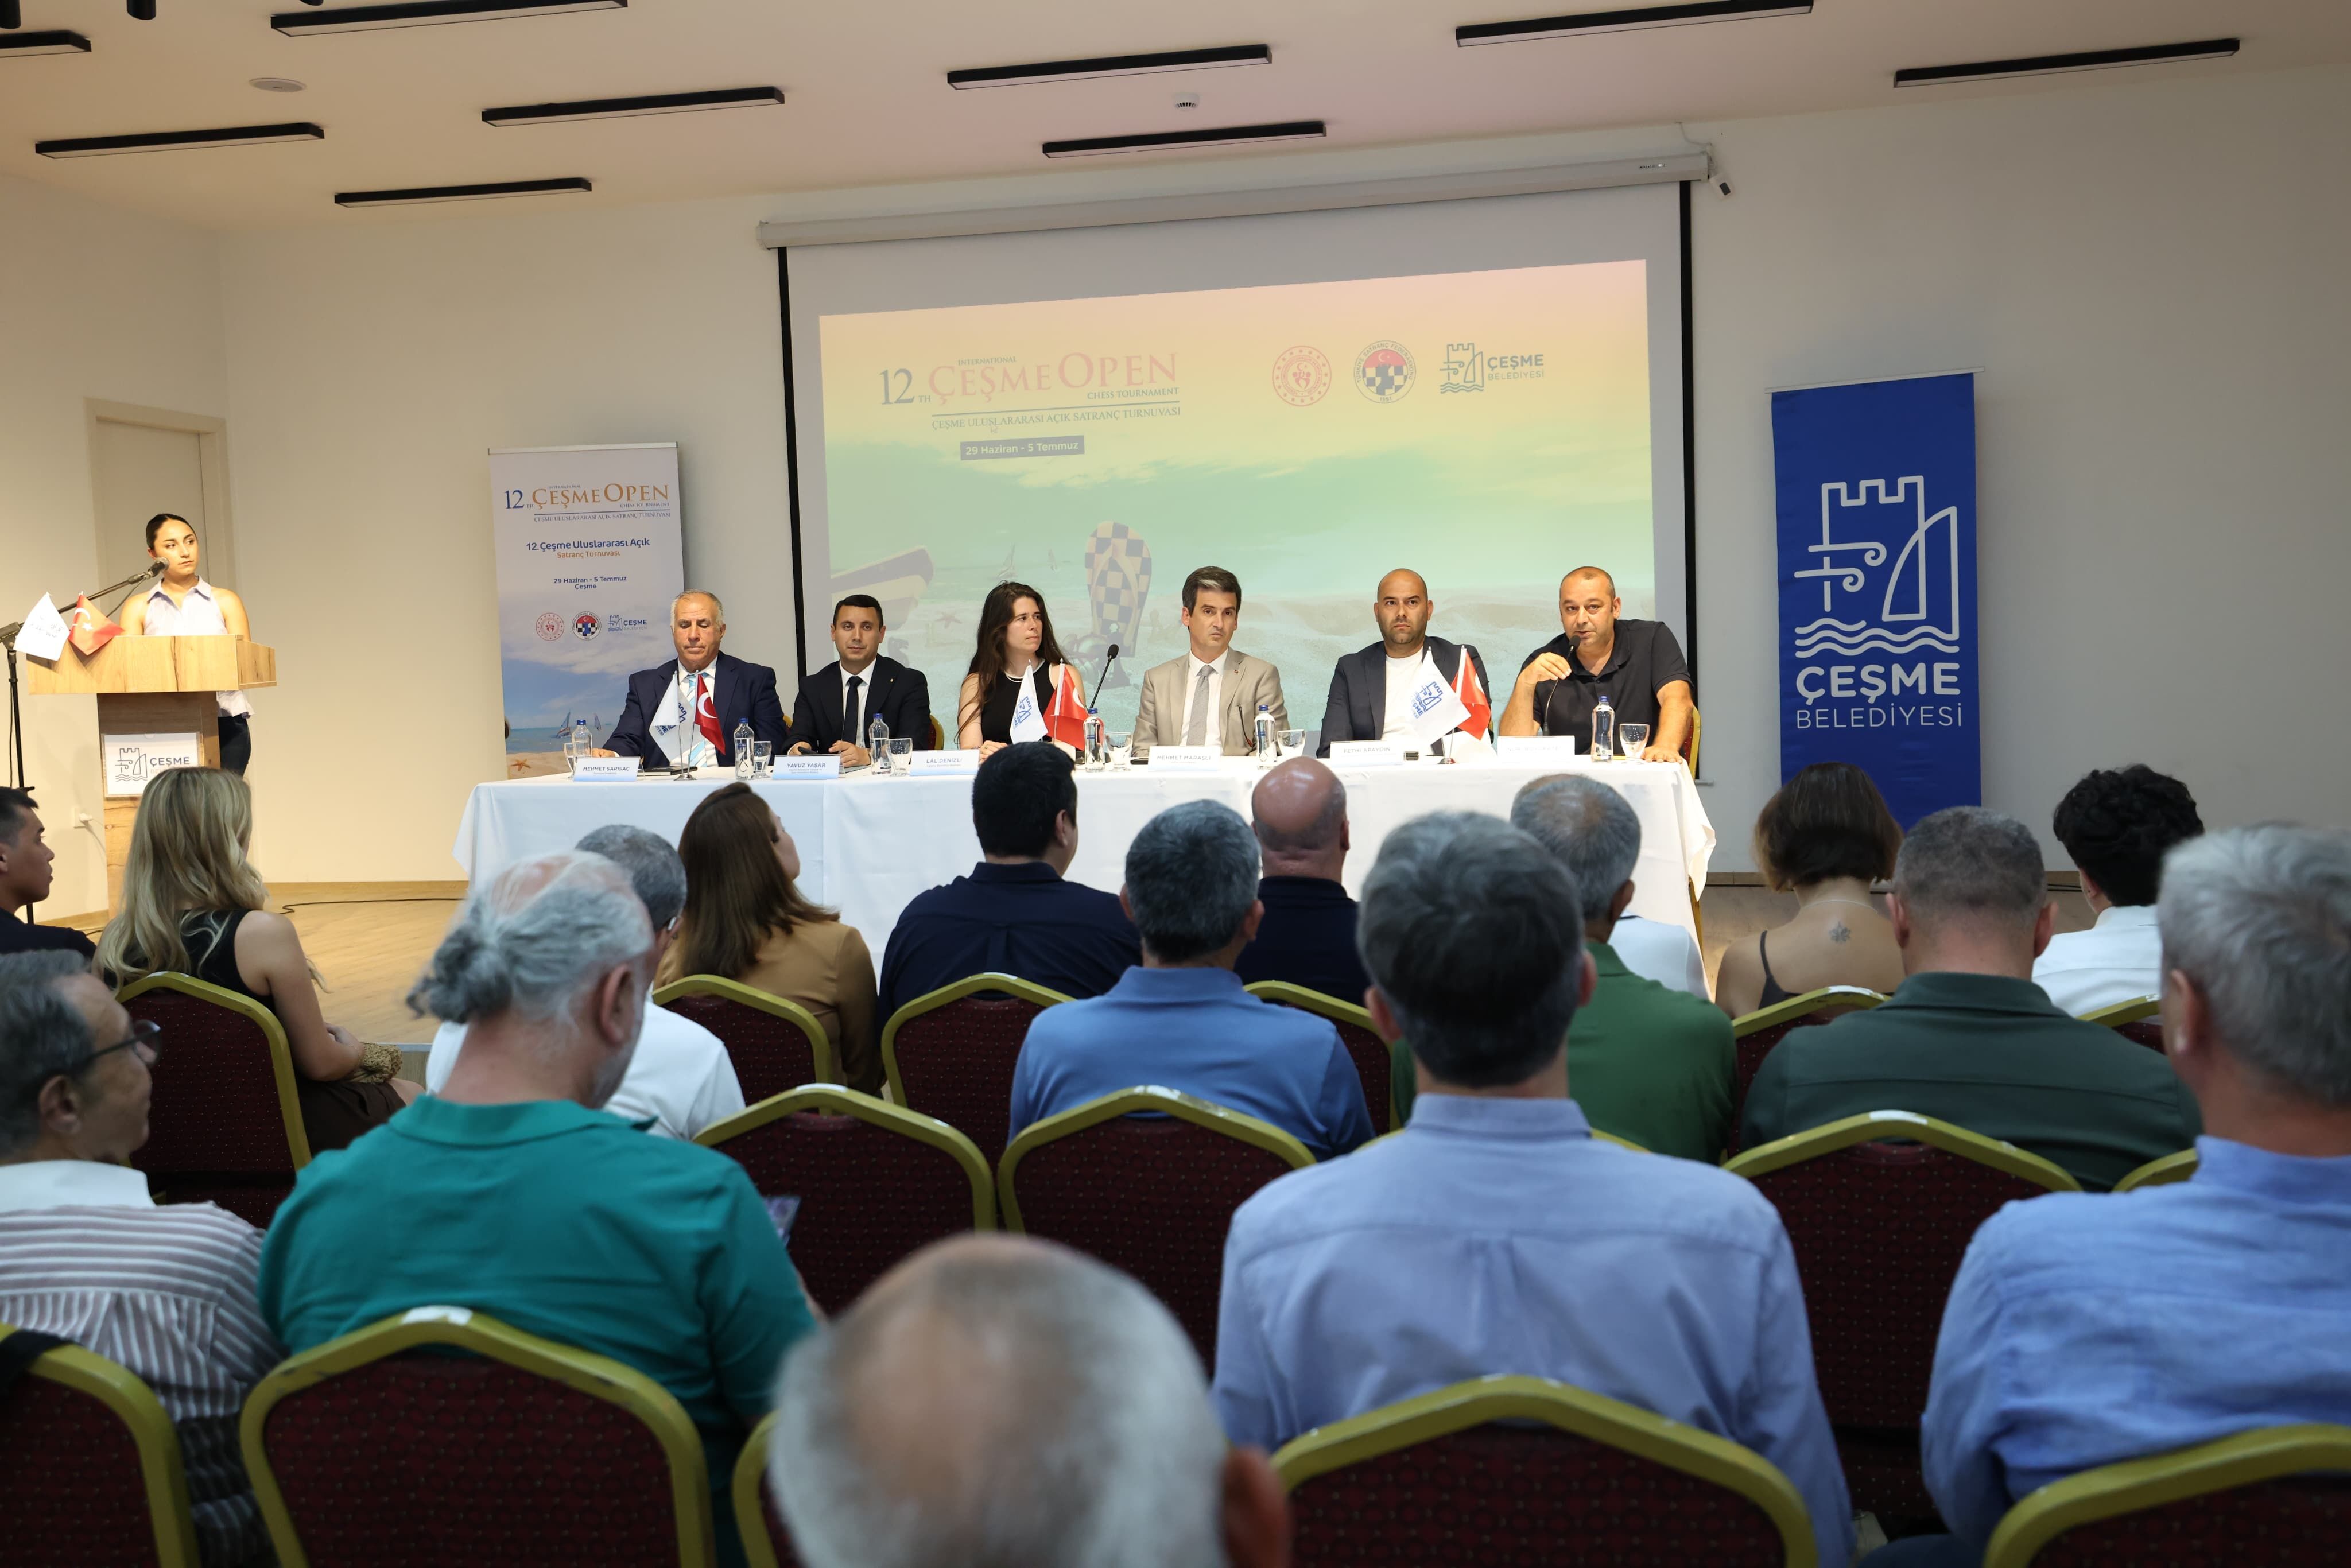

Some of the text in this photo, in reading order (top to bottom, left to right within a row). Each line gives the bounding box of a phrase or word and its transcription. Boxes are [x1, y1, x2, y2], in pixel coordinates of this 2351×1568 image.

[957, 356, 1017, 366] INTERNATIONAL
[1487, 354, 1543, 371] ÇEŞME
[878, 352, 1178, 405] 12 TH ÇEŞME OPEN
[1087, 387, 1180, 400] CHESS TOURNAMENT
[932, 418, 965, 430] ÇEŞME
[1046, 413, 1071, 424] AÇIK
[1074, 410, 1120, 421] SATRANÇ
[1123, 407, 1181, 418] TURNUVASI
[965, 446, 978, 455] 29
[981, 445, 1018, 455] Haziran
[1028, 443, 1033, 452] 5
[1037, 441, 1079, 451] Temmuz
[505, 490, 524, 509] 12
[532, 488, 600, 509] ÇEŞME
[604, 483, 669, 502] OPEN
[526, 538, 650, 552] 12. Çeşme Uluslararası Açık
[1796, 662, 1961, 705] ÇEŞME
[1797, 703, 1961, 729] BELEDİYESİ
[150, 756, 190, 767] ÇEŞME
